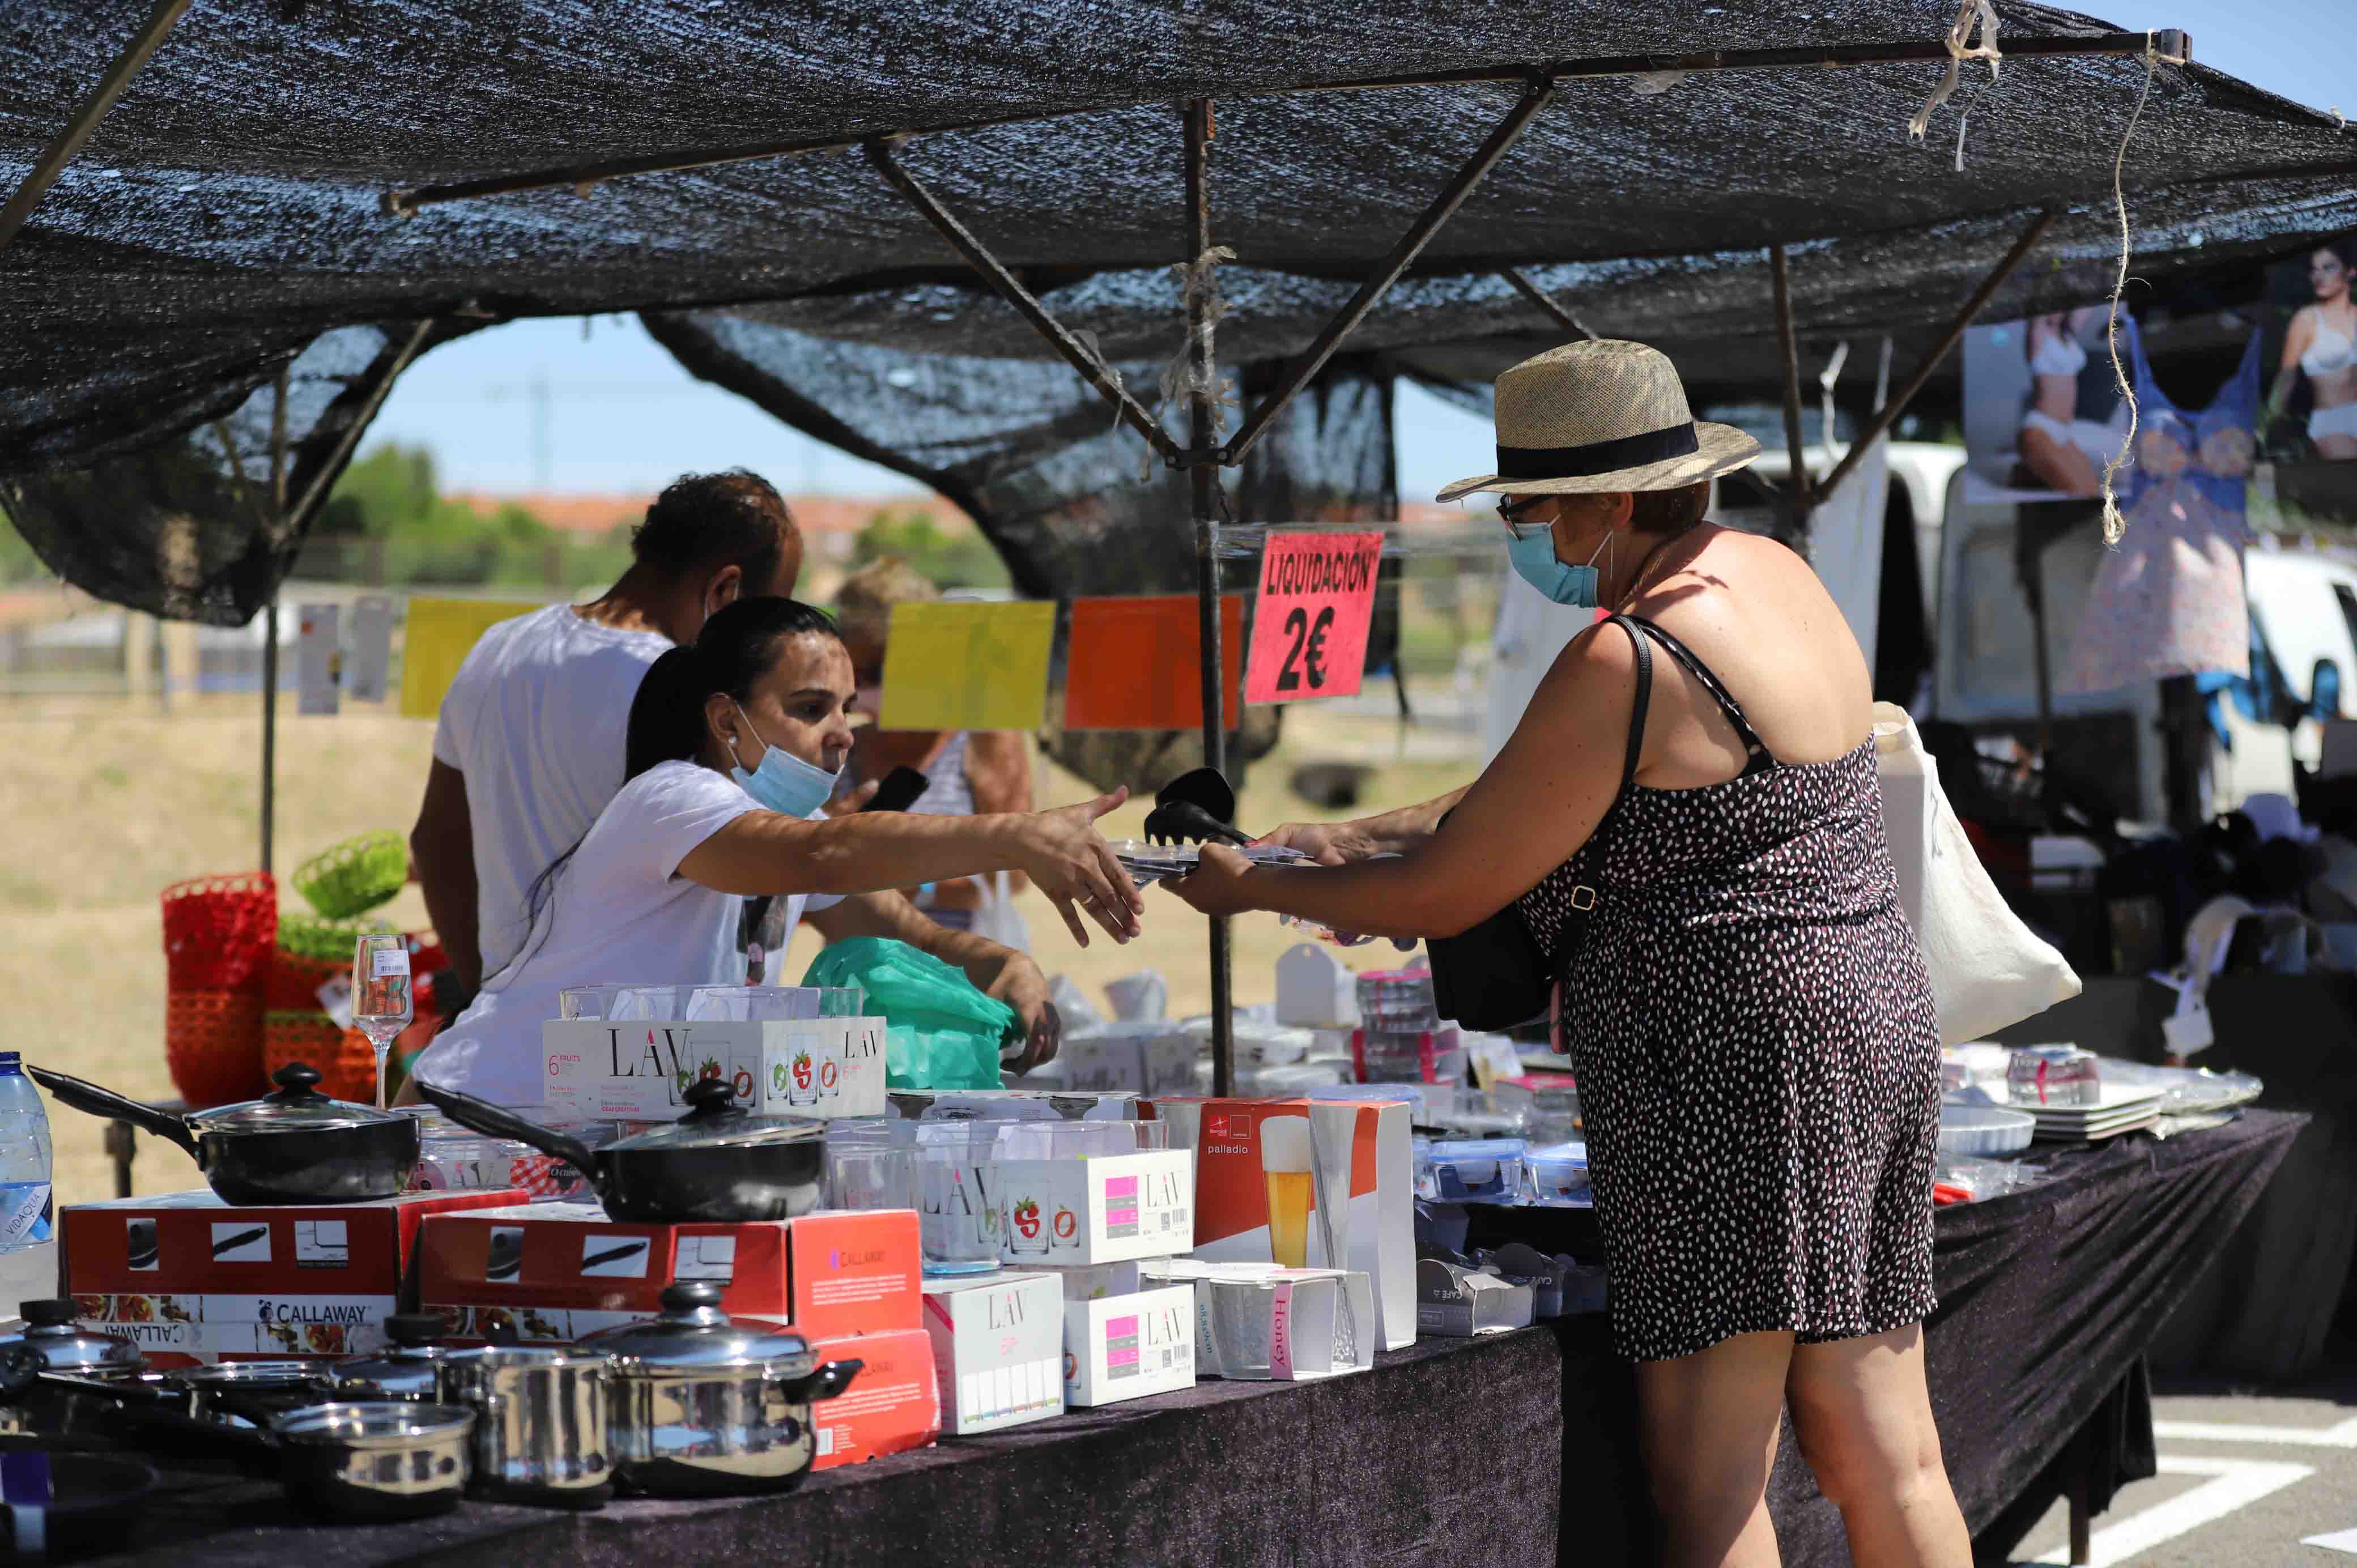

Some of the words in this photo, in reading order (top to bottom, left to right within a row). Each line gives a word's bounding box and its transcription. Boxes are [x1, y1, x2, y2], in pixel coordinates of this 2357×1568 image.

[1266, 541, 1377, 598] LIQUIDACIÓN
[1276, 606, 1335, 691] 2€
[607, 1029, 692, 1077] LAV
[844, 1030, 885, 1059] LAV
[1208, 1144, 1248, 1155] palladio
[1145, 1171, 1184, 1207] LAV
[277, 1305, 366, 1323] CALLAWAY
[988, 1288, 1029, 1330] LAV
[1145, 1306, 1186, 1345] LAV
[1274, 1299, 1288, 1368] Honey
